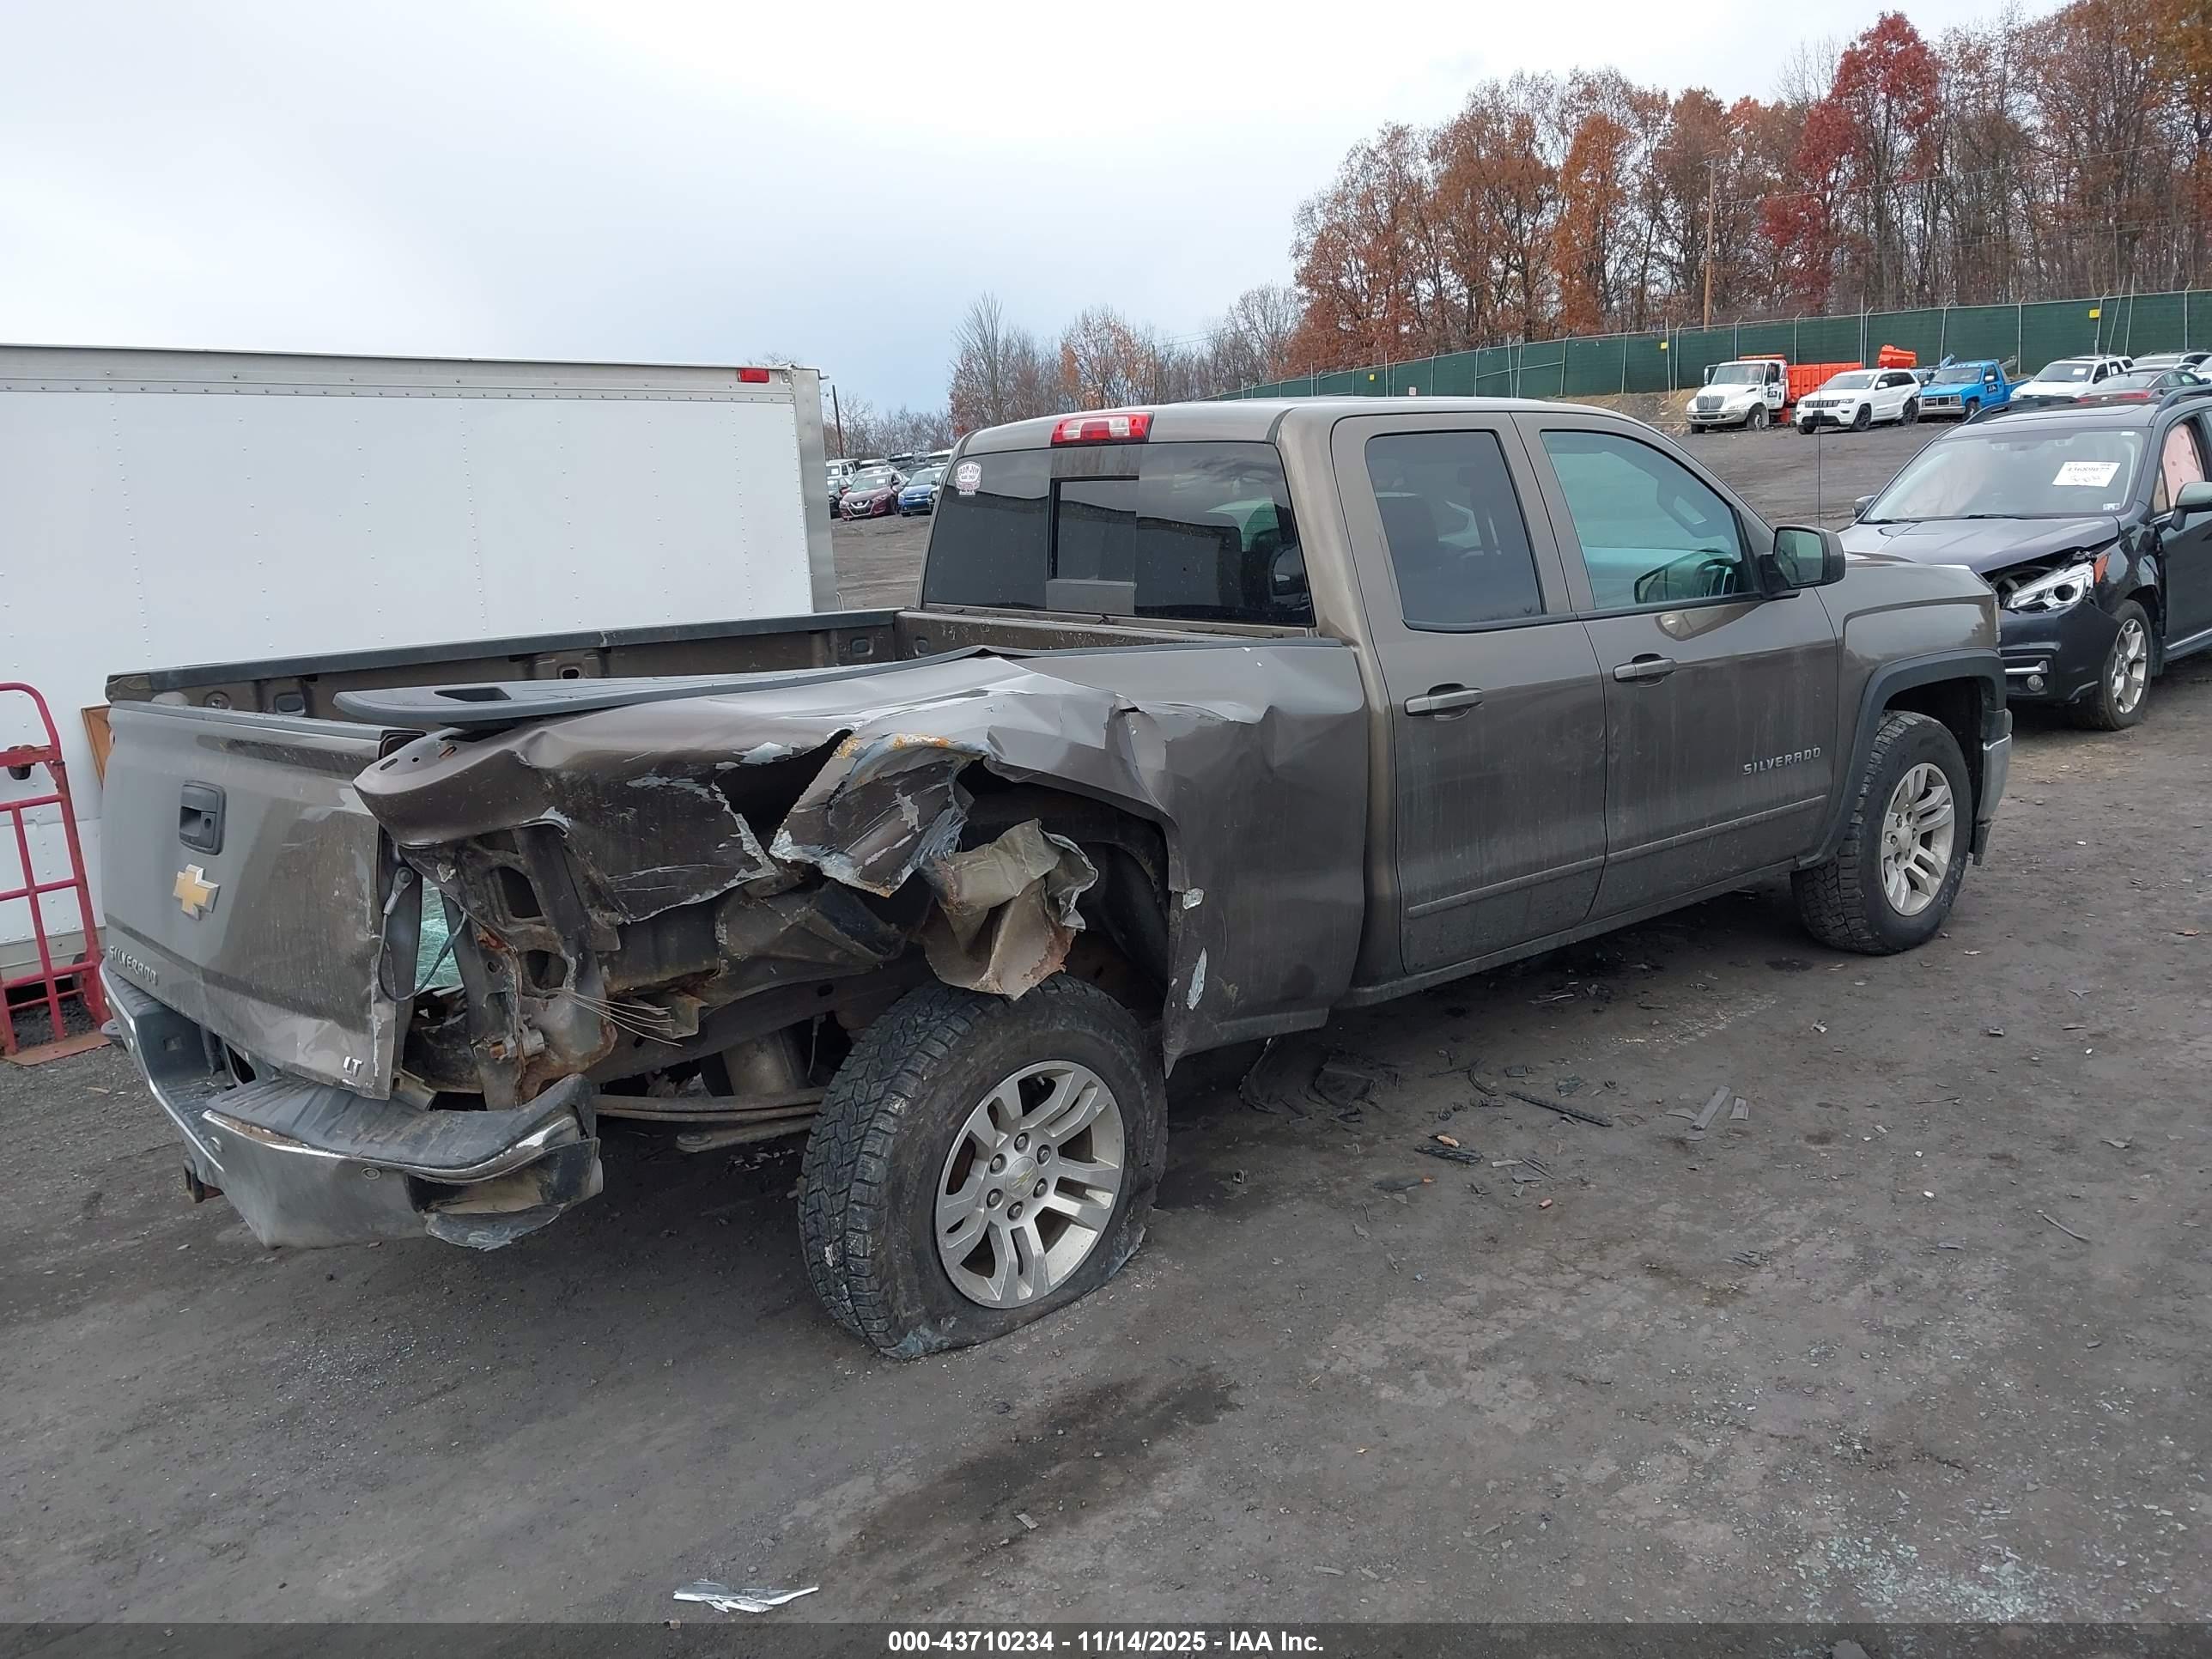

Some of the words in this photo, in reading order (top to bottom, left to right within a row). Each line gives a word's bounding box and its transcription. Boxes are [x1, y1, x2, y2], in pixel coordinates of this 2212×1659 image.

[1743, 747, 1820, 775] SILVERADO
[109, 945, 157, 984] SILVERADO
[343, 1056, 363, 1076] LT
